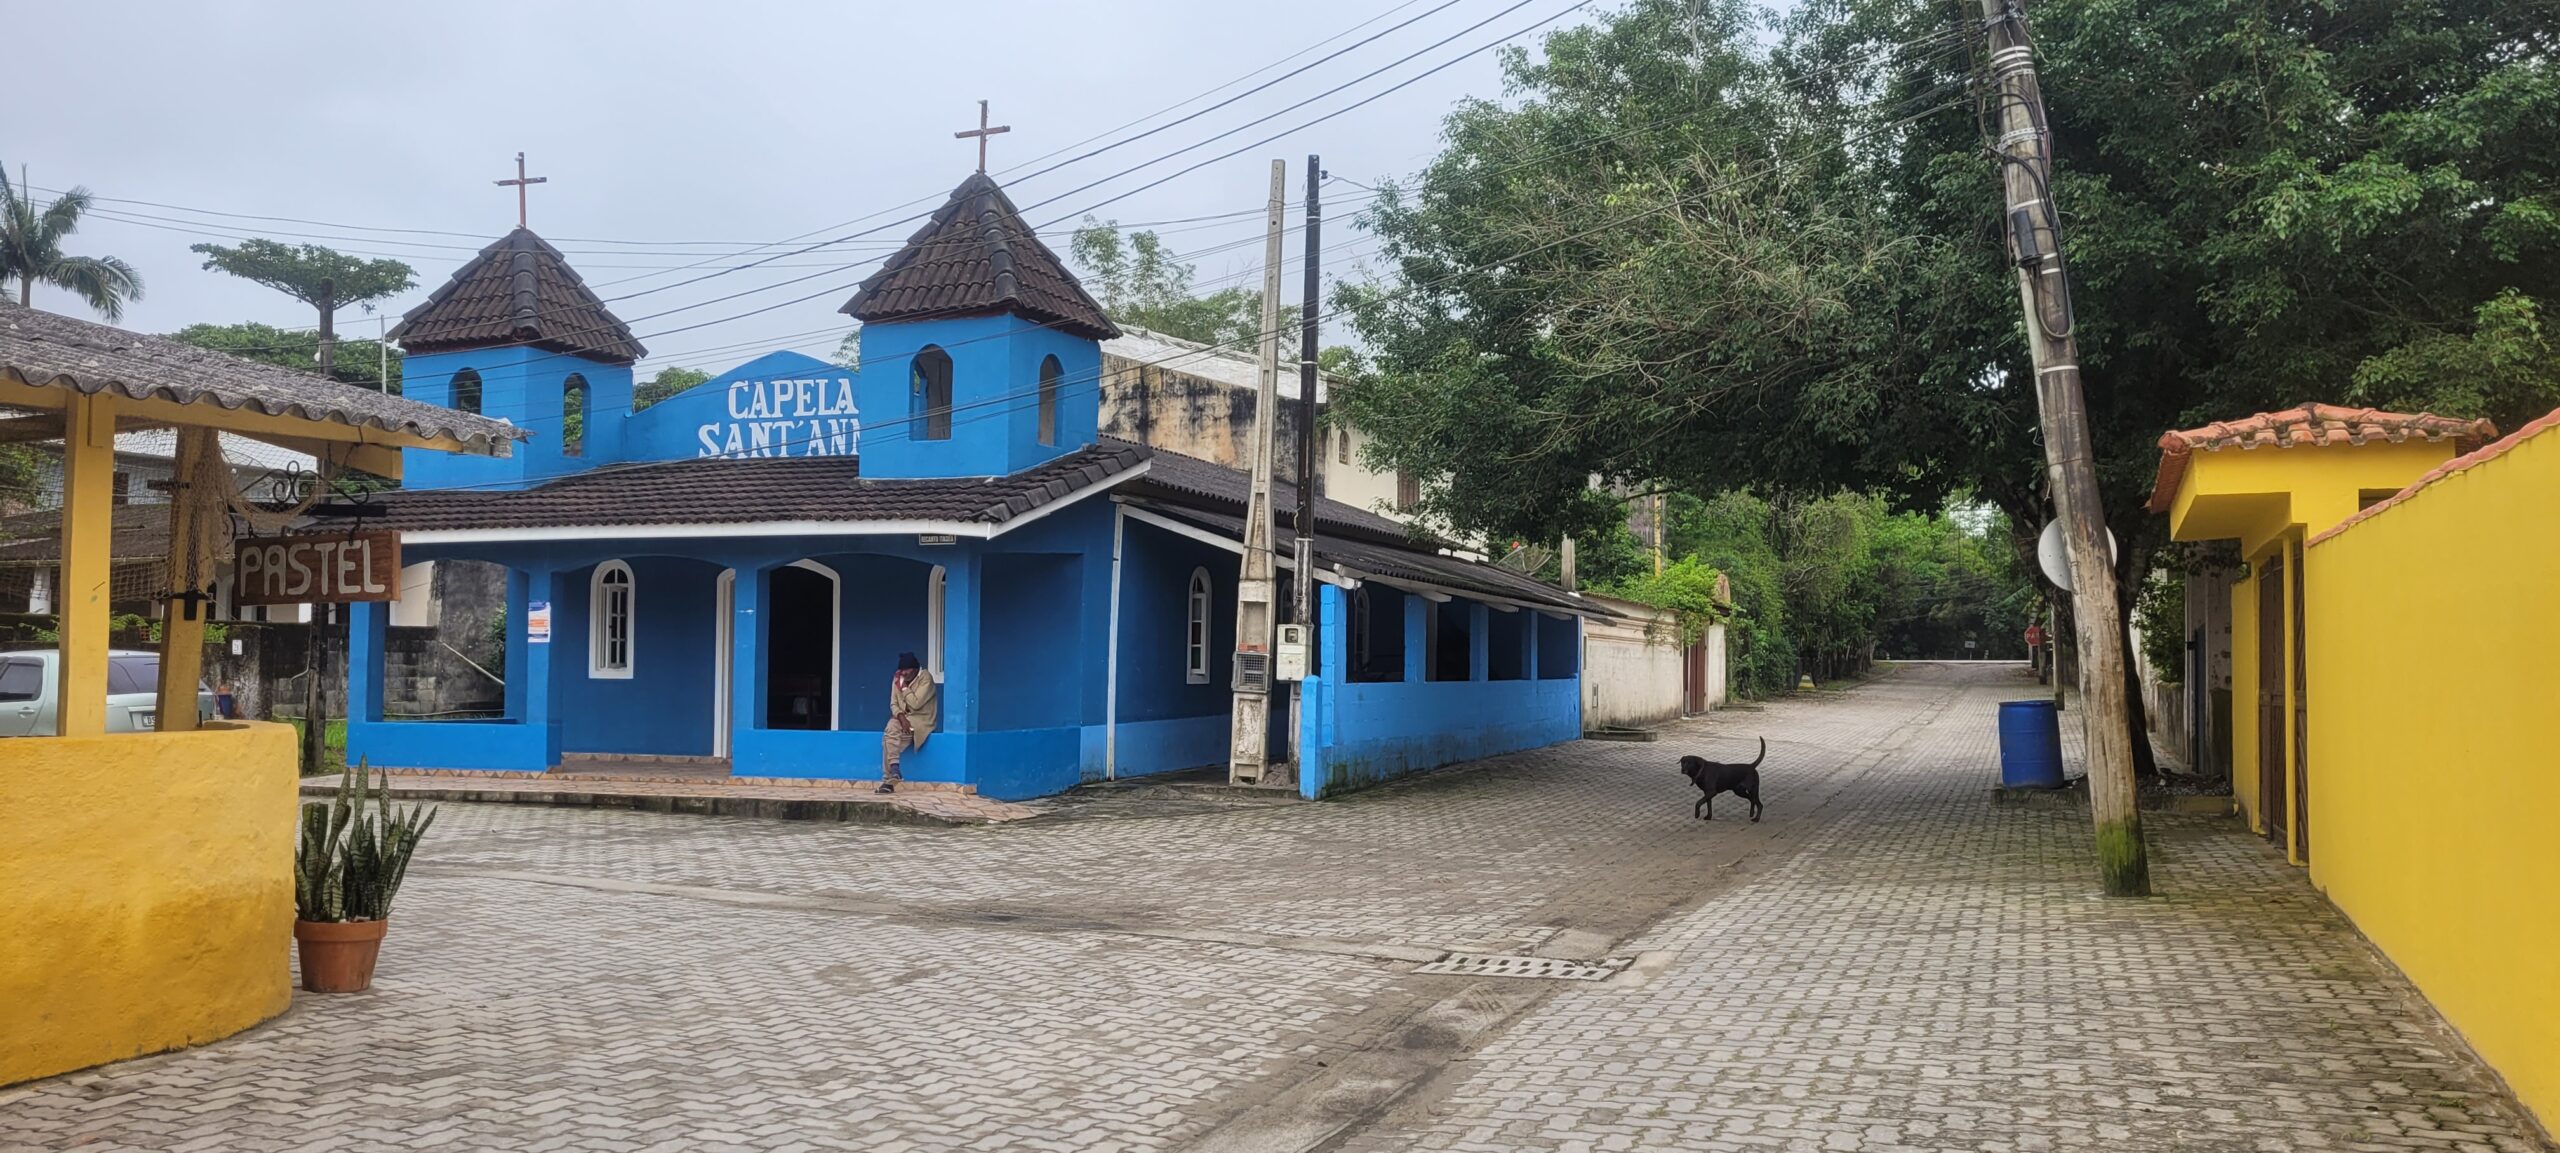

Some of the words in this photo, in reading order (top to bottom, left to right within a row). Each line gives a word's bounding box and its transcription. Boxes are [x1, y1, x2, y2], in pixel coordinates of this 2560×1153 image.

[728, 378, 859, 419] CAPELA
[698, 419, 860, 459] SANT'ANN
[240, 539, 386, 597] PASTEL
